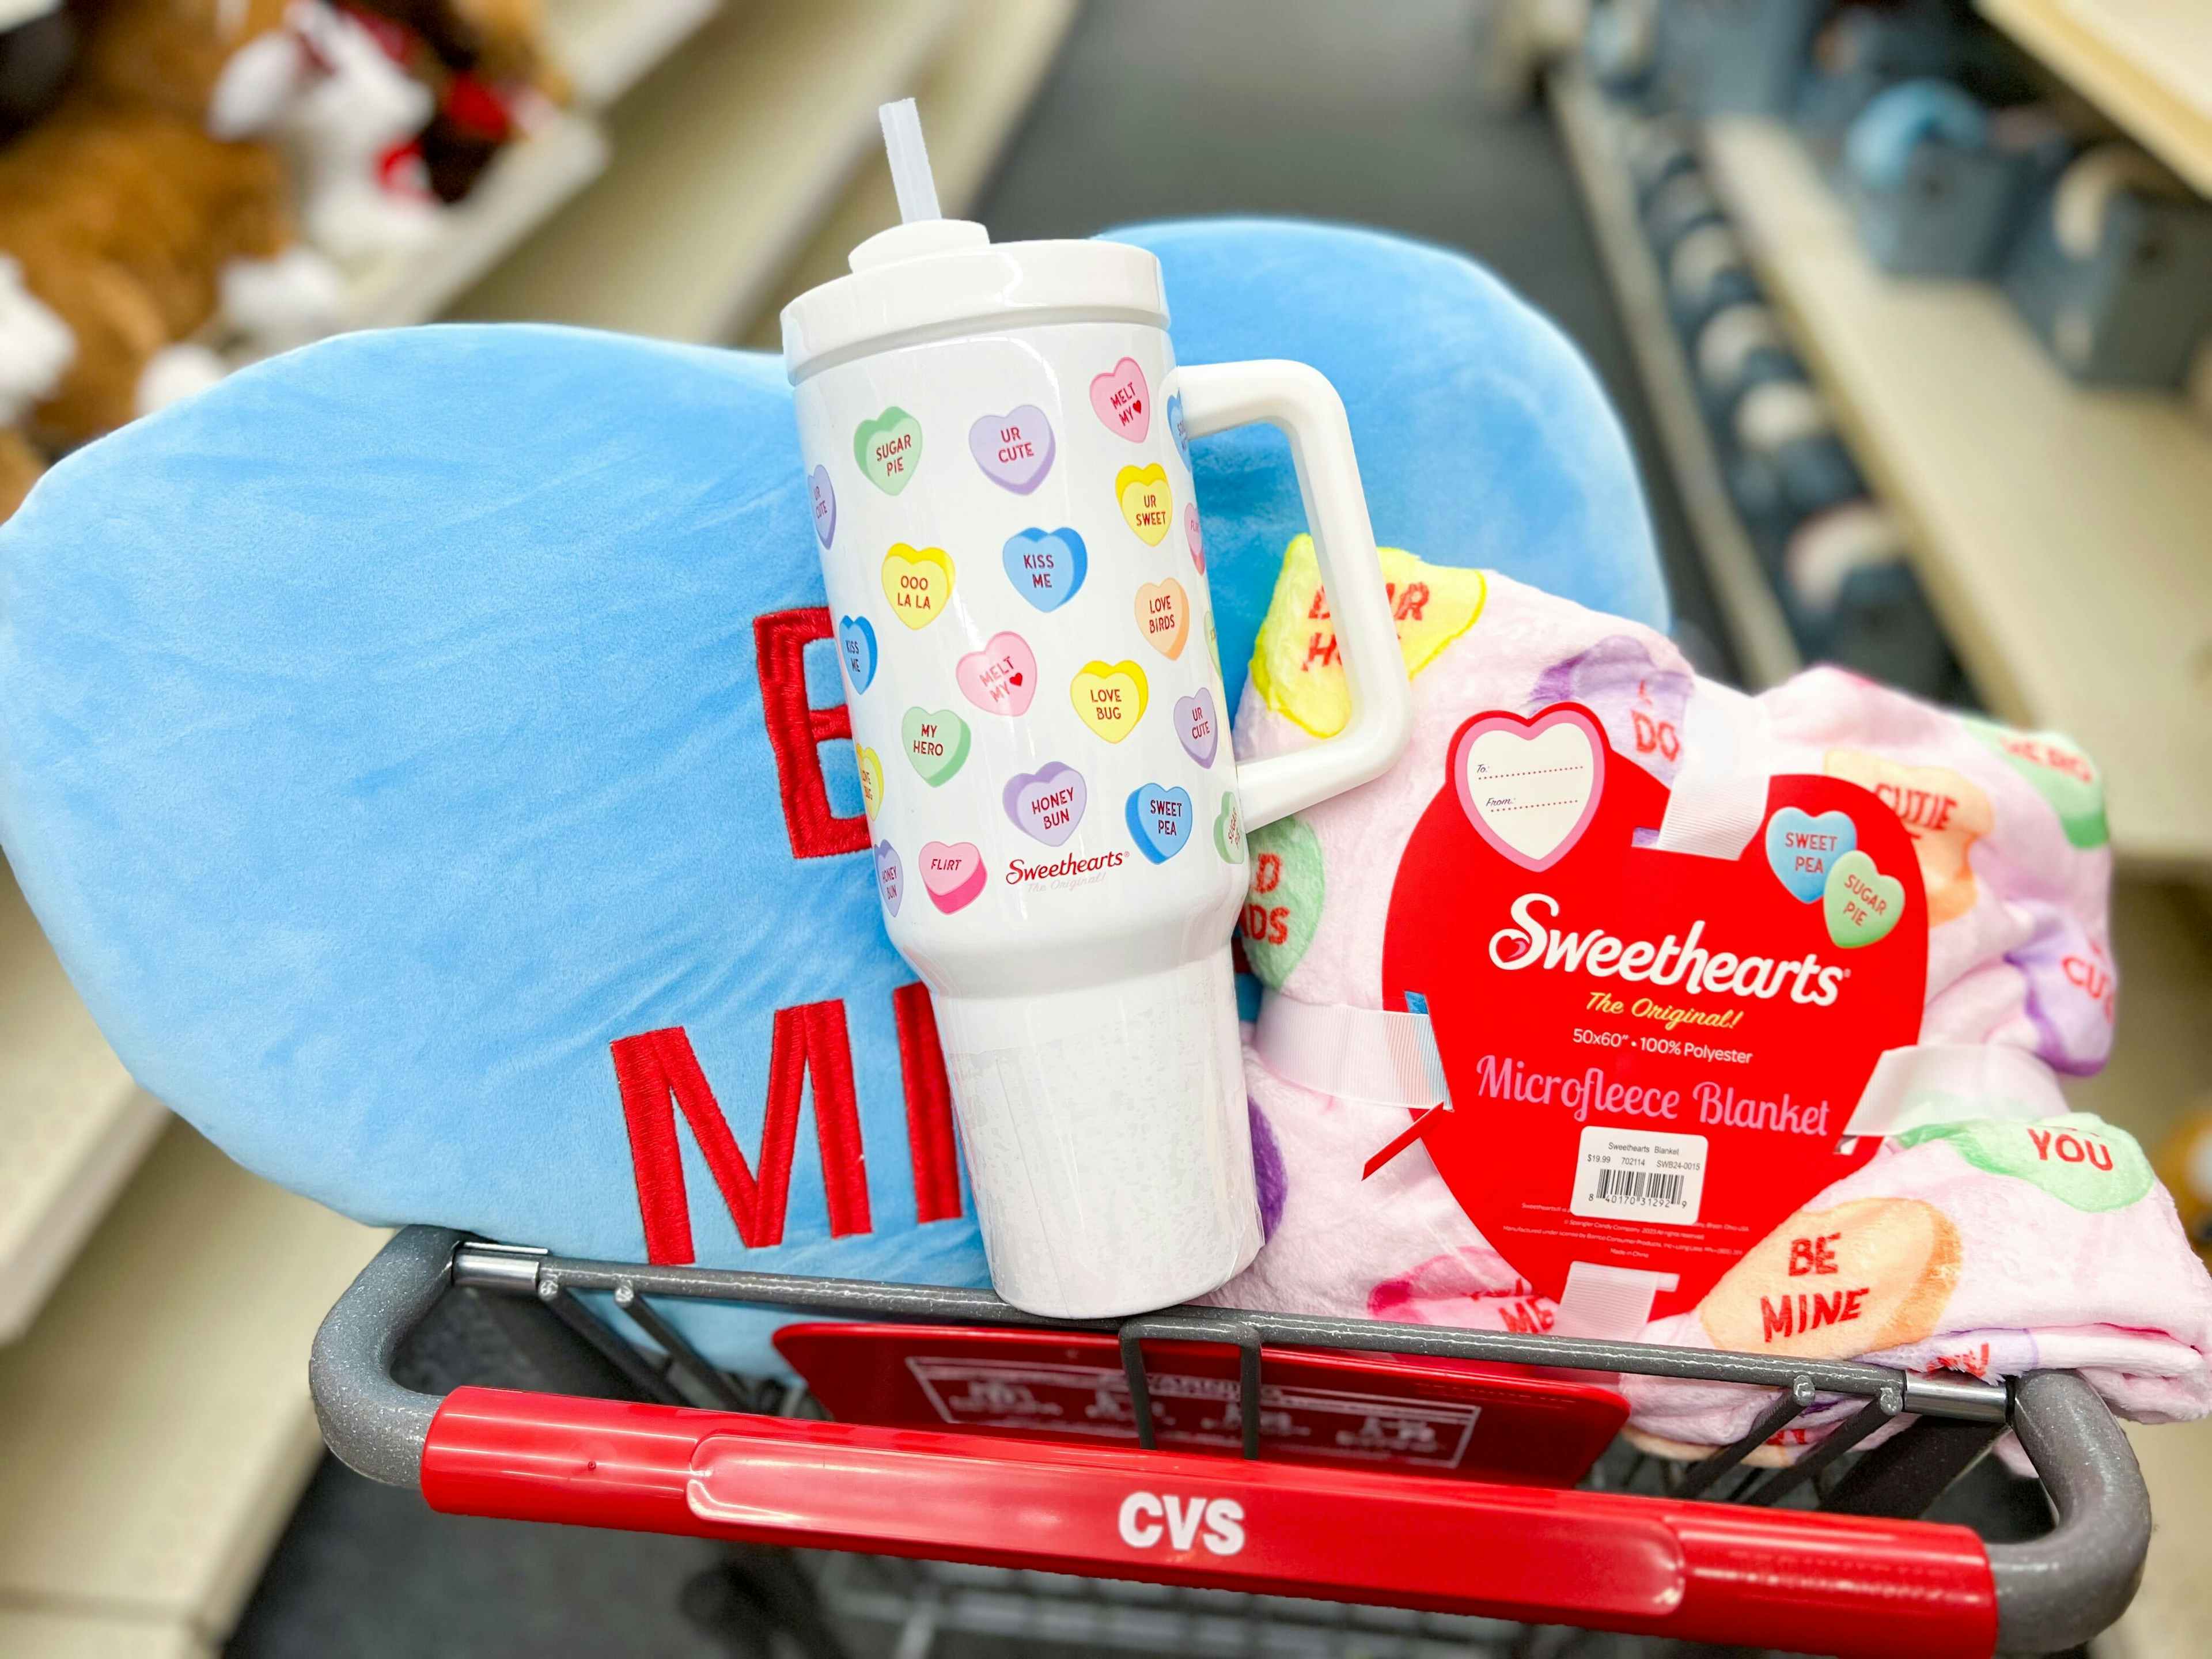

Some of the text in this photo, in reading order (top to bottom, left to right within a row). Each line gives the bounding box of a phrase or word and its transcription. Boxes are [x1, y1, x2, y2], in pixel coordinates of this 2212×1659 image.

[1109, 381, 1137, 410] MELT
[1118, 406, 1135, 427] MY
[1001, 426, 1022, 444] UR
[876, 434, 912, 461] SUGAR
[998, 442, 1035, 463] CUTE
[886, 456, 904, 476] PIE
[1143, 494, 1157, 508] UR
[1135, 511, 1166, 527] SWEET
[1023, 554, 1055, 570] KISS
[900, 575, 929, 591] OOO
[1032, 574, 1053, 589] ME
[897, 593, 931, 610] LA LA
[1149, 596, 1172, 615] LOVE
[1149, 615, 1176, 634] BIRDS
[846, 640, 859, 656] KISS
[850, 658, 861, 673] ME
[979, 656, 1016, 688] MELT
[990, 680, 1011, 703] MY
[1090, 689, 1122, 703] LOVE
[1096, 706, 1122, 720] BUG
[1192, 707, 1203, 721] UR
[921, 724, 937, 739] MY
[1191, 722, 1210, 740] CUTE
[1631, 709, 1680, 762] DO
[913, 741, 944, 756] HERO
[1477, 764, 1490, 773] To:
[1032, 787, 1074, 815] HONEY
[1150, 799, 1182, 817] SWEET
[1486, 798, 1516, 806] From:
[1043, 810, 1070, 831] BUN
[1158, 819, 1177, 836] PEA
[1785, 832, 1838, 851] SWEET
[930, 858, 962, 872] FLIRT
[1795, 857, 1824, 874] PEA
[882, 866, 896, 884] HONEY
[887, 885, 897, 900] BUN
[1028, 883, 1046, 893] The
[1844, 874, 1887, 916] SUGAR
[1843, 902, 1866, 927] PIE
[1586, 992, 1744, 1030] The Original!
[1641, 1037, 1681, 1056] 100%
[1684, 1043, 1753, 1065] Polyester
[1476, 1055, 1830, 1137] Microfleece Blanket
[611, 979, 964, 1265] MI
[1608, 1142, 1679, 1155] Sweethearts Blanket
[2027, 1128, 2113, 1171] YOU
[1588, 1154, 1700, 1171] $19.99 702114 SWB24-0015
[1789, 1232, 1841, 1276] BE
[1760, 1287, 1870, 1343] MINE
[1118, 1491, 1246, 1555] CVS
